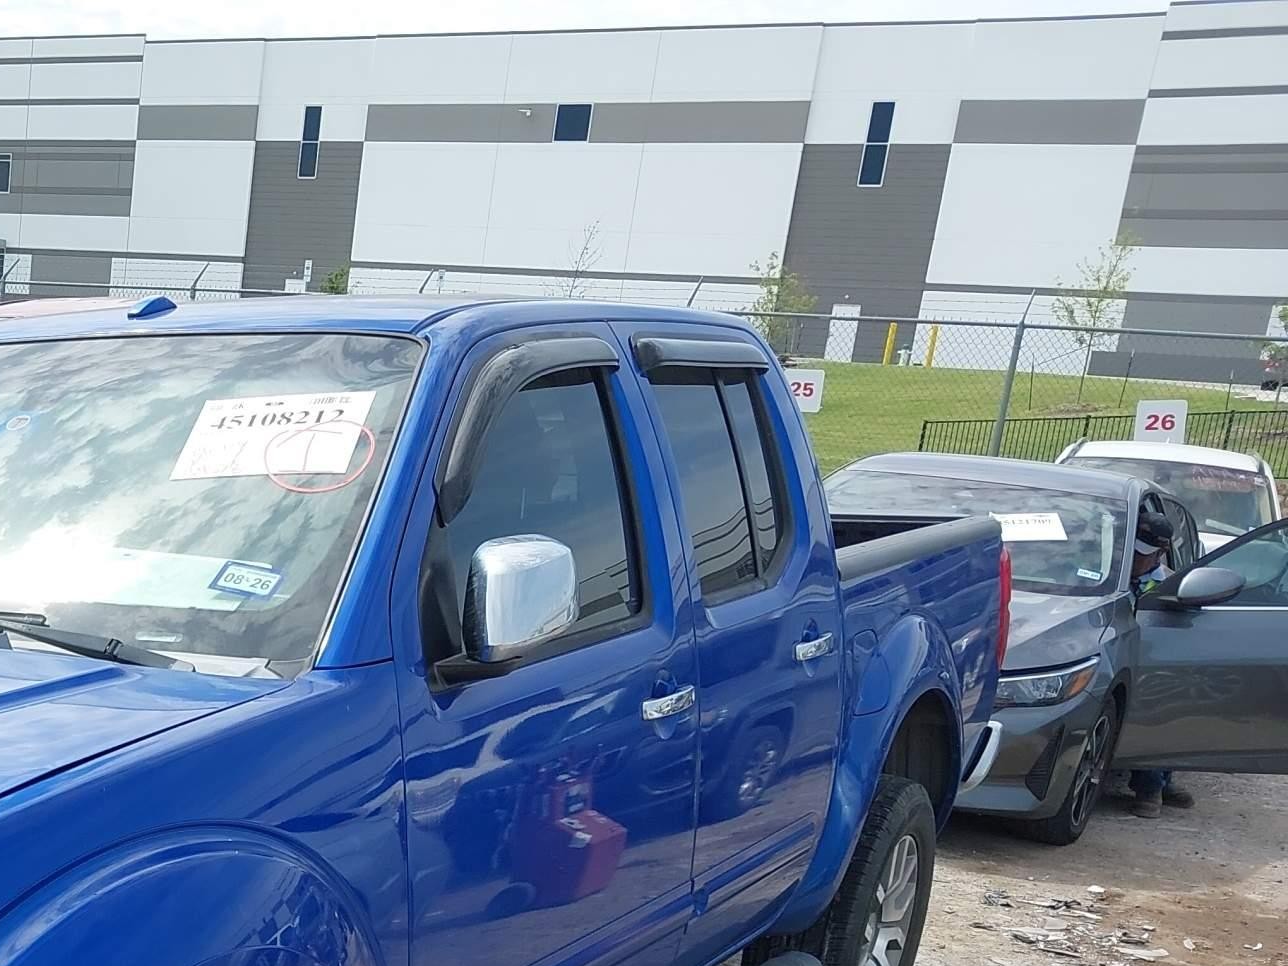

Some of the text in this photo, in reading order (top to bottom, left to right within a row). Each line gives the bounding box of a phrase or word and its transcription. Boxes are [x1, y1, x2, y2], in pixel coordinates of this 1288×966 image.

[790, 381, 814, 397] 25
[210, 409, 345, 430] 45108212
[1144, 414, 1175, 430] 26
